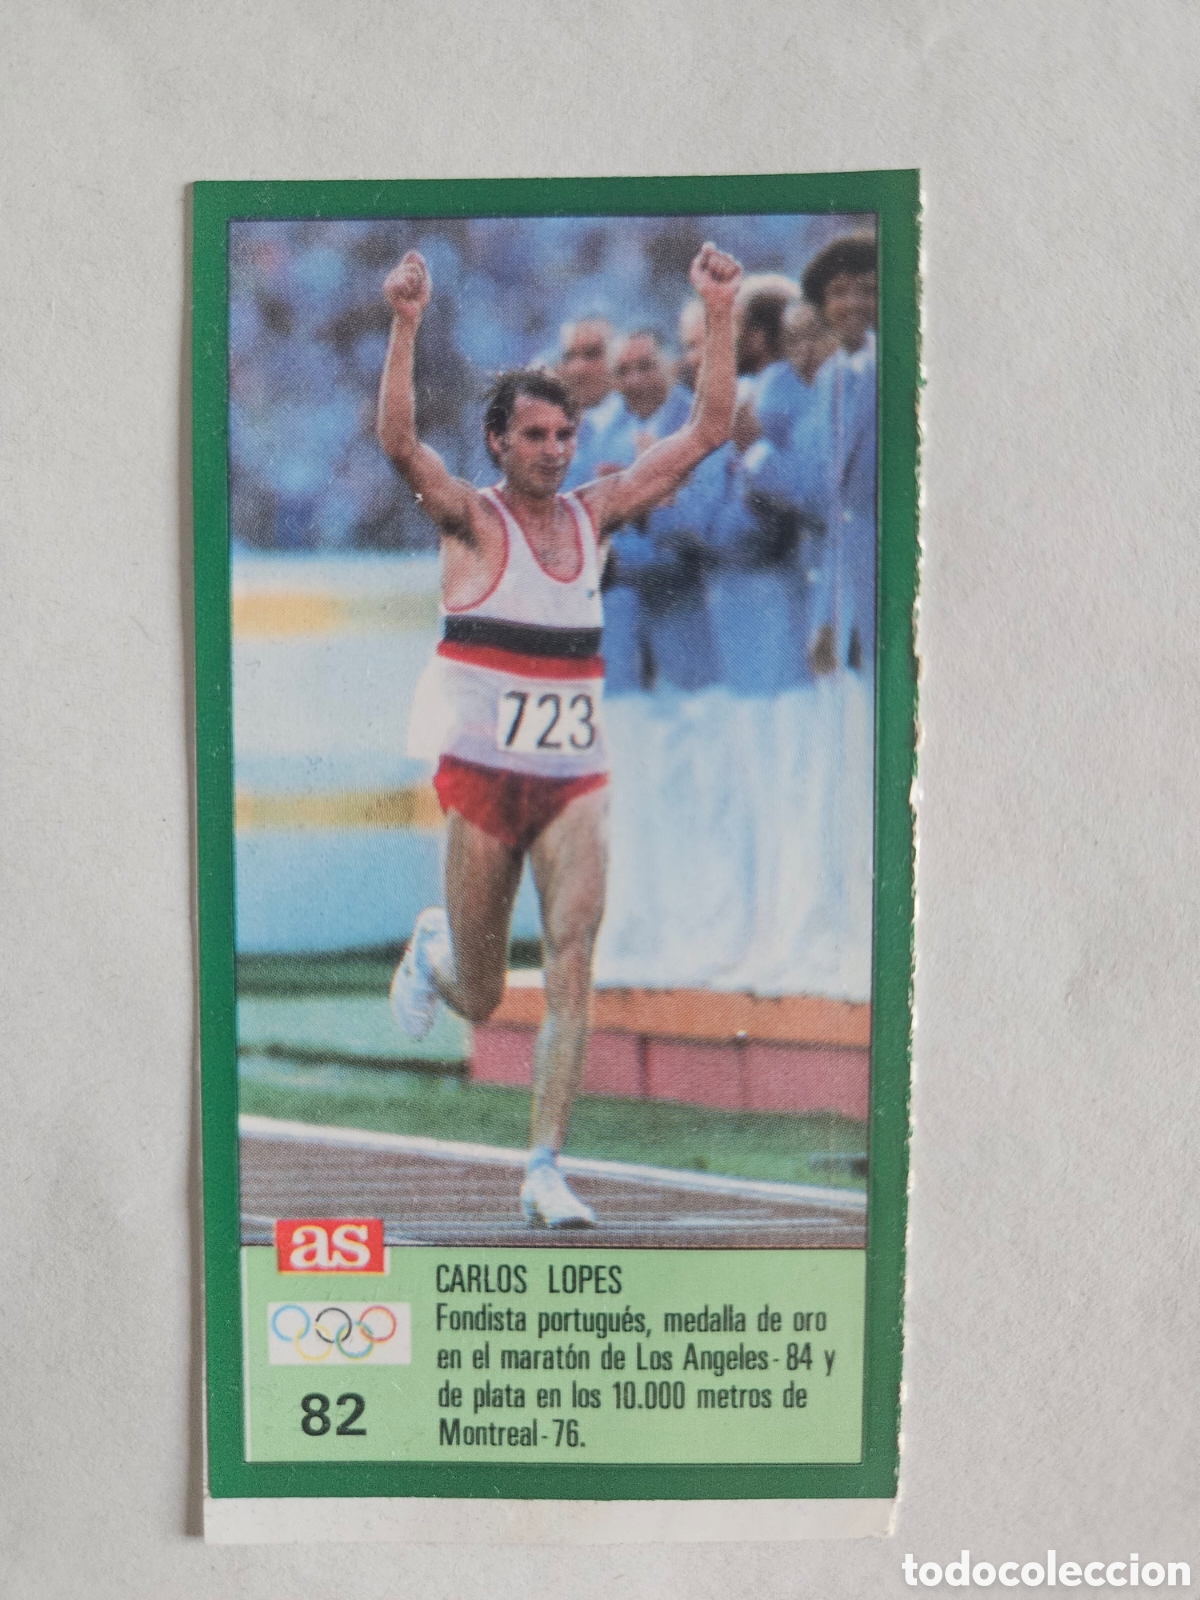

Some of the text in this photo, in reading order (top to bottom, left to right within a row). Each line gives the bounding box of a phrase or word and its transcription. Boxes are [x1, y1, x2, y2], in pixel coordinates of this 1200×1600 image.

[504, 690, 595, 750] 723
[289, 1223, 371, 1270] as
[435, 1263, 623, 1295] CARLOS LOPES
[436, 1302, 827, 1339] Fondista portugués, medalla de oro
[437, 1348, 462, 1370] en
[472, 1341, 490, 1370] el
[500, 1342, 590, 1371] maratón
[600, 1342, 626, 1371] de
[636, 1342, 673, 1371] Los
[823, 1349, 836, 1377] y
[300, 1391, 367, 1437] 82
[438, 1379, 808, 1415] de plata en los 10.000 metros de
